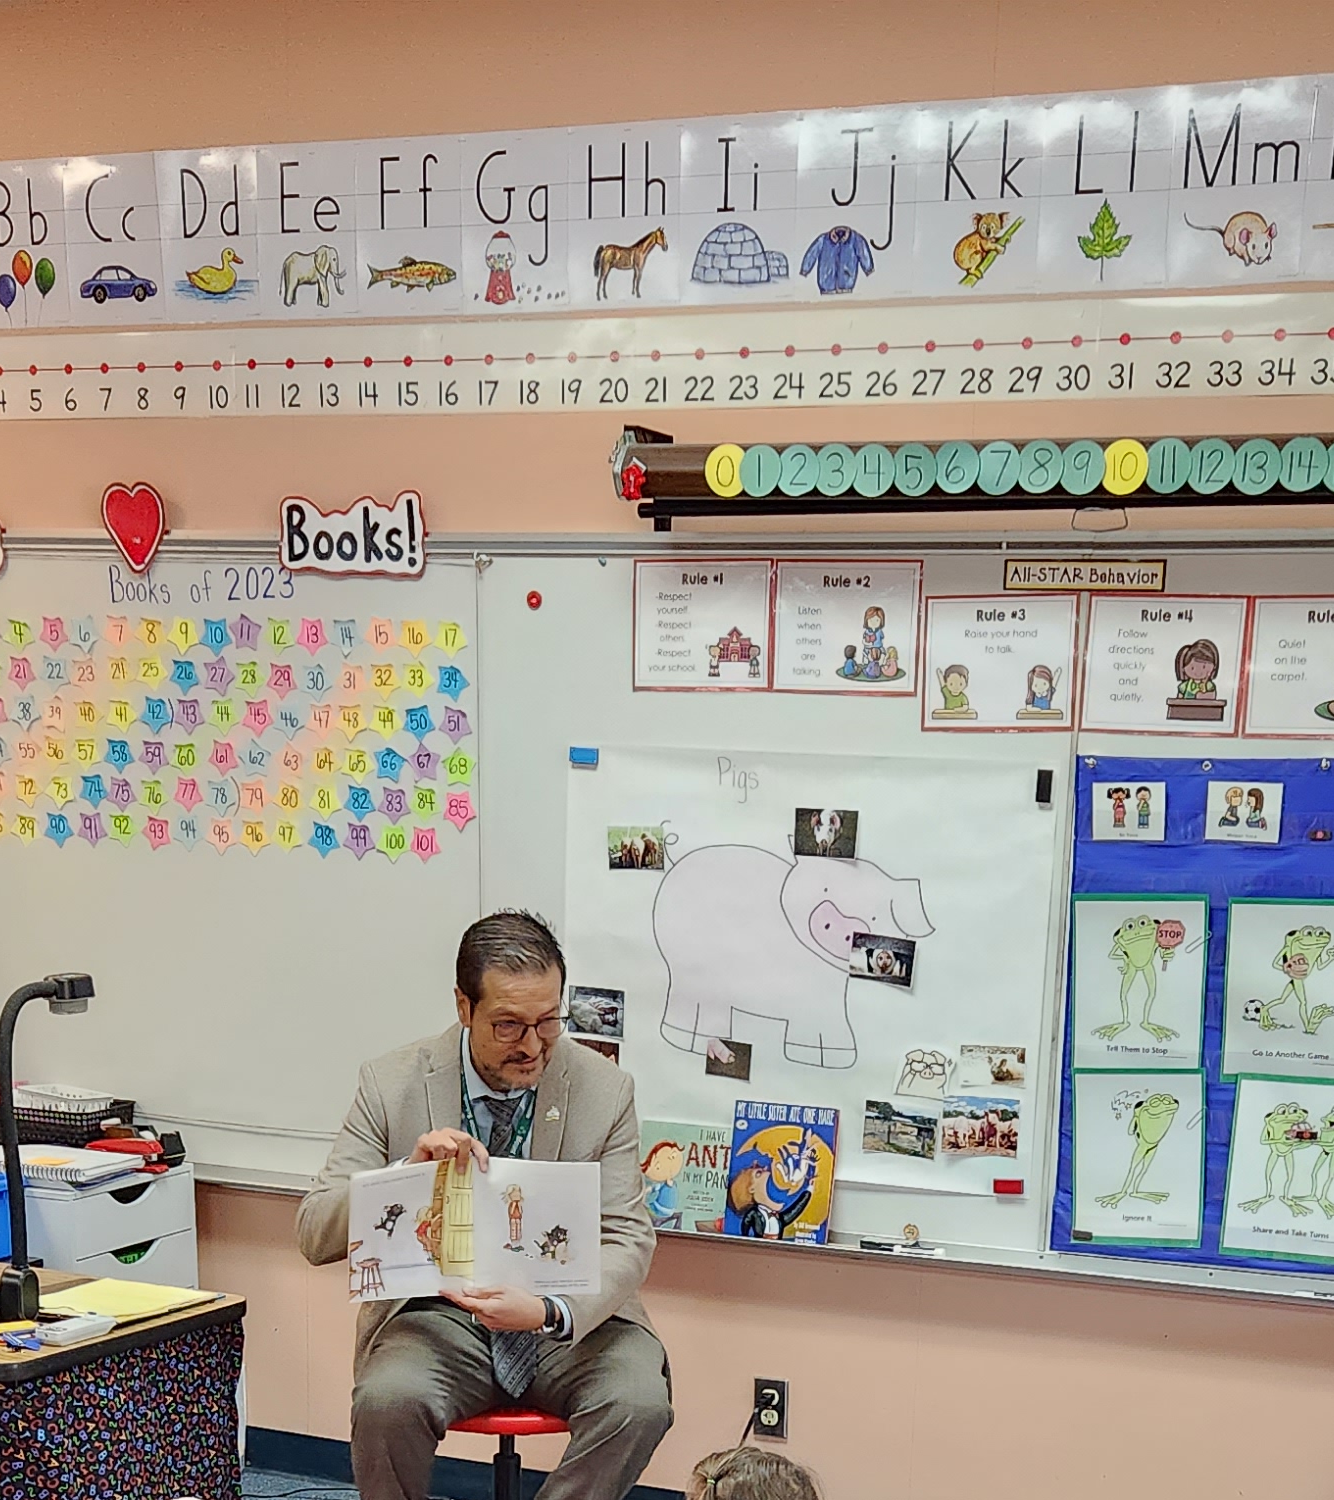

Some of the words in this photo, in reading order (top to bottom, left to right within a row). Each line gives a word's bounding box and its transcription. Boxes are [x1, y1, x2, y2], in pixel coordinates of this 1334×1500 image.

[281, 384, 300, 408] 12
[599, 379, 628, 403] 20
[959, 368, 993, 395] 28
[1056, 364, 1090, 392] 30
[1110, 451, 1139, 479] 10
[287, 499, 416, 567] Books!
[109, 566, 171, 604] Books
[190, 568, 210, 604] of
[226, 566, 294, 599] 2023
[823, 575, 851, 587] Rule
[856, 576, 871, 587] #2
[1010, 566, 1084, 582] All-STAR
[1089, 569, 1158, 585] Behavior
[976, 609, 1005, 622] Rule
[1011, 609, 1026, 621] #3
[209, 626, 224, 646] 10
[965, 630, 988, 638] Raise
[991, 631, 1010, 639] your
[1013, 629, 1037, 638] hand
[985, 645, 997, 654] to
[1108, 644, 1154, 654] directions
[443, 670, 459, 690] 34
[410, 711, 427, 731] 50
[381, 751, 398, 769] 66
[718, 756, 759, 803] Pigs
[415, 835, 436, 852] 101
[1158, 928, 1182, 942] STOP
[1275, 1051, 1305, 1059] Another
[1308, 1052, 1329, 1060] Game
[737, 1104, 747, 1117] MY
[748, 1105, 767, 1120] LITTLE
[768, 1105, 787, 1121] SISTER
[789, 1106, 800, 1122] ATE
[803, 1107, 815, 1124] ONE
[818, 1109, 835, 1126] HARE
